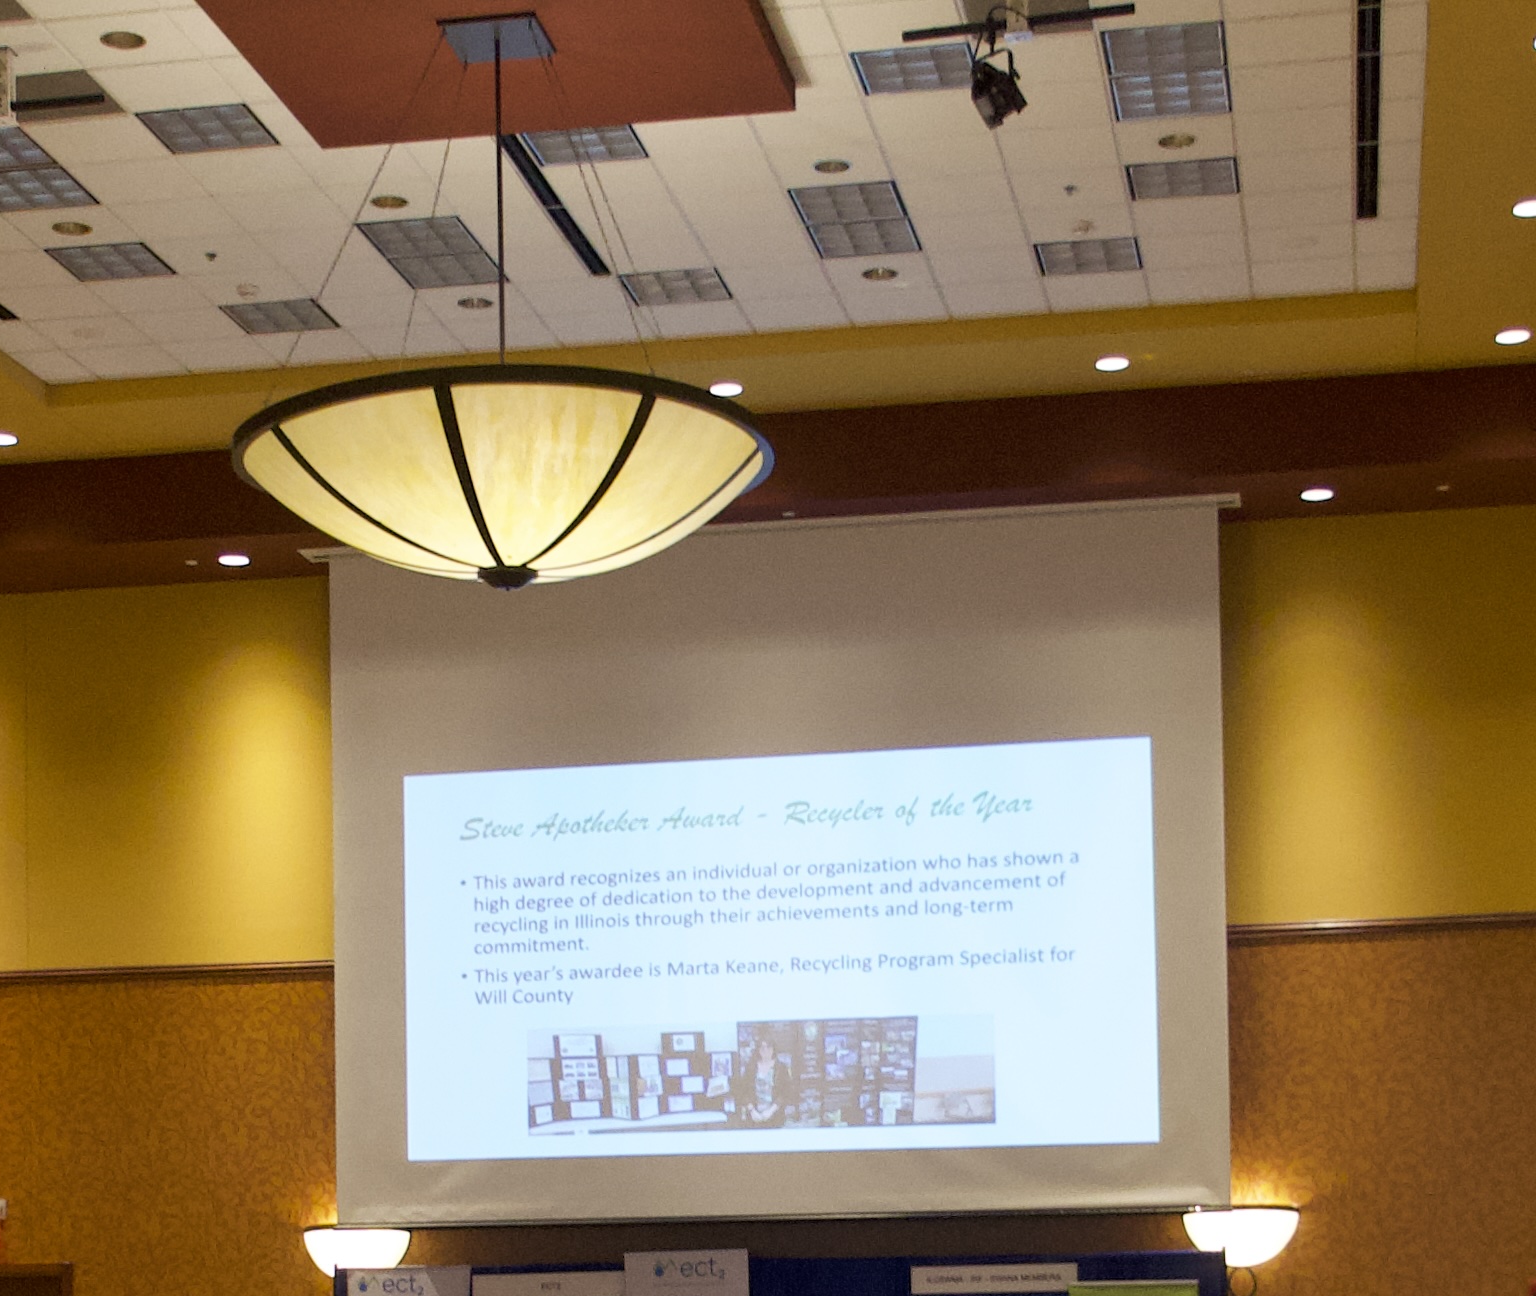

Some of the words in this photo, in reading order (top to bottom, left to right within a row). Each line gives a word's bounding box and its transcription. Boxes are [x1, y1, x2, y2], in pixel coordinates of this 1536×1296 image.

[459, 817, 524, 841] Steve
[530, 810, 651, 841] Apotheker
[657, 805, 745, 831] Award
[784, 797, 884, 828] Recycler
[895, 796, 918, 826] of
[931, 792, 965, 818] the
[972, 790, 1034, 823] Year
[473, 873, 507, 890] This
[513, 872, 565, 888] award
[570, 868, 661, 889] recognizes
[666, 867, 687, 882] an
[693, 862, 777, 880] individual
[783, 863, 800, 877] or
[807, 857, 917, 878] organization
[922, 854, 962, 871] who
[967, 853, 998, 869] has
[1003, 851, 1064, 867] shown
[1069, 851, 1080, 864] a
[474, 896, 510, 914] high
[515, 894, 574, 912] degree
[579, 891, 597, 907] of
[602, 887, 694, 906] dedication
[698, 888, 717, 902] to
[722, 885, 751, 901] the
[756, 881, 873, 900] development
[880, 878, 913, 895] and
[919, 875, 1042, 894] advancement
[1047, 871, 1066, 887] of
[474, 916, 548, 935] recycling
[554, 915, 569, 930] in
[575, 912, 630, 929] Illinois
[635, 909, 704, 928] through
[710, 908, 751, 923] their
[756, 904, 879, 922] achievements
[885, 900, 919, 917] and
[924, 898, 1013, 916] long-term
[474, 938, 590, 955] commitment.
[474, 968, 508, 983] This
[514, 965, 564, 985] year's
[569, 963, 643, 980] awardee
[649, 962, 662, 977] is
[667, 960, 720, 976] Marta
[726, 957, 784, 974] Keane,
[791, 953, 872, 975] Recycling
[878, 951, 954, 971] Program
[960, 946, 1044, 967] Specialist
[1050, 945, 1076, 962] for
[475, 989, 507, 1005] Will
[512, 988, 574, 1005] County
